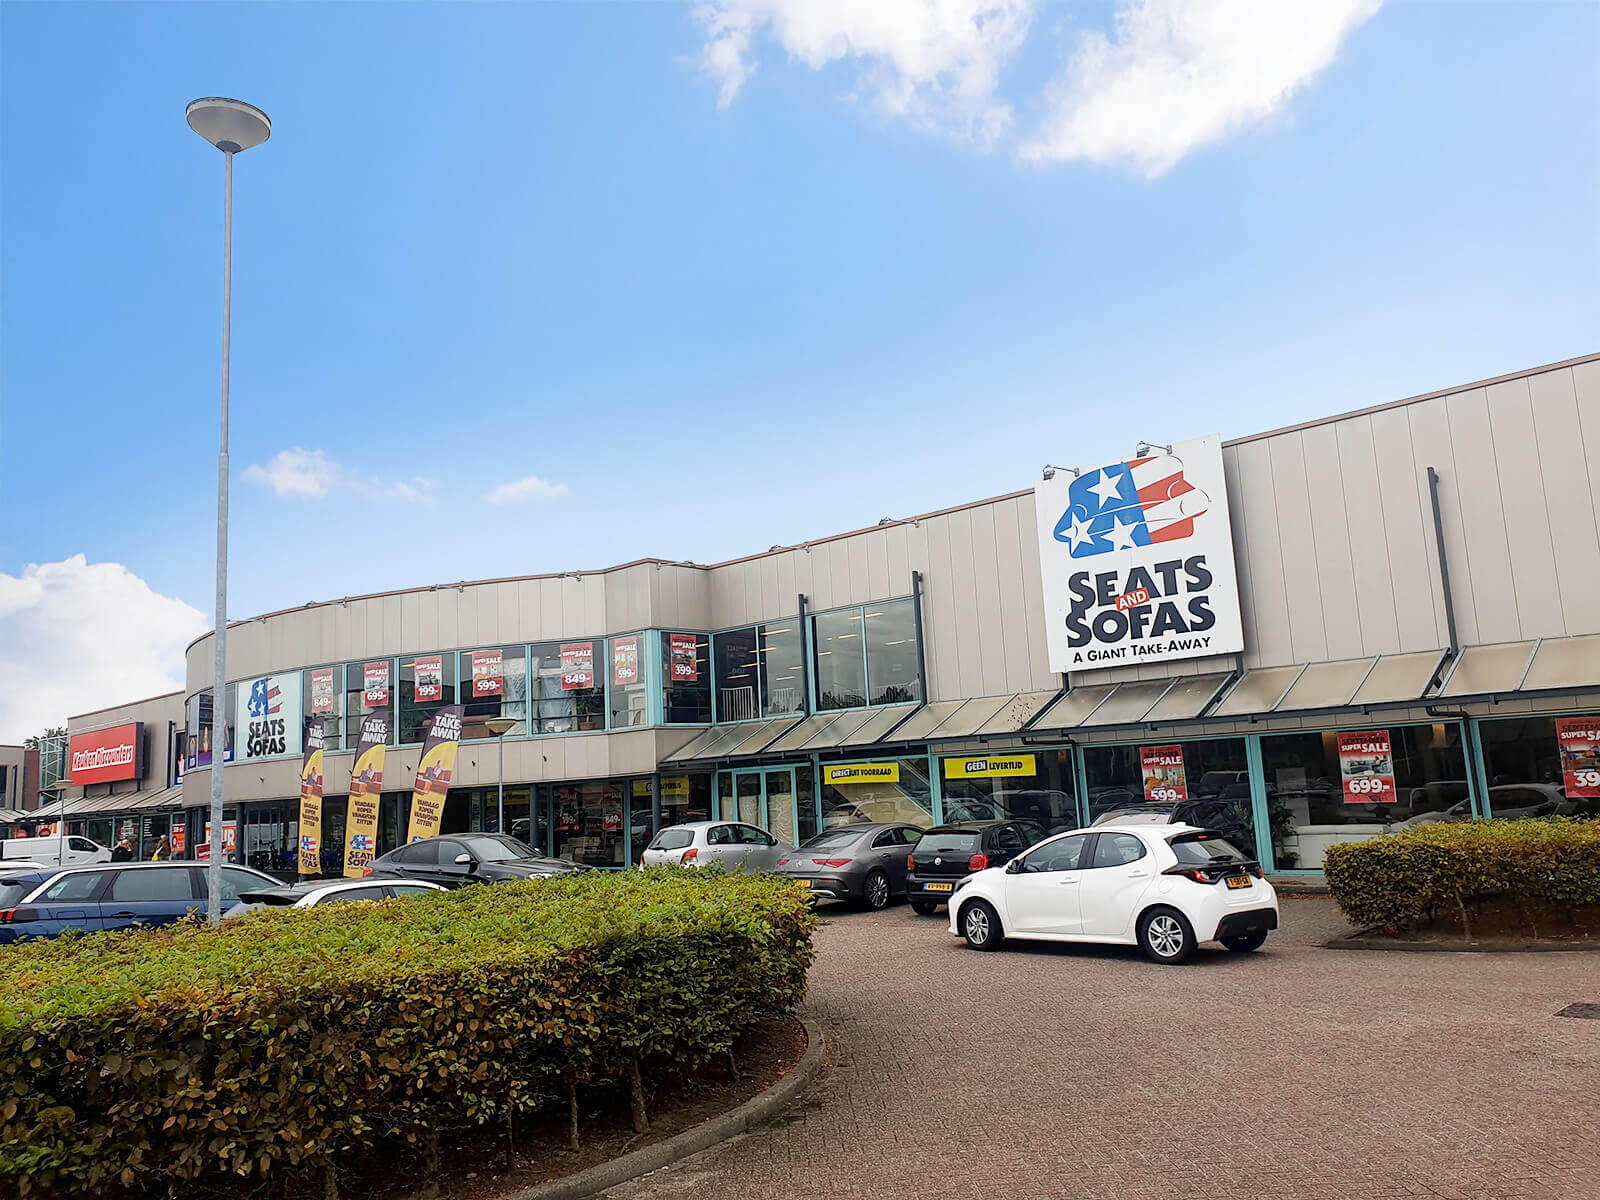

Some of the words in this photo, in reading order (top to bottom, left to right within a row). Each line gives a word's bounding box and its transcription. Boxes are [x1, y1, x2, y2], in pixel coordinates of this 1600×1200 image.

[1068, 555, 1212, 610] SEATS
[1119, 591, 1147, 609] AND
[1065, 596, 1216, 648] SOFAS
[1073, 652, 1083, 663] A
[1087, 647, 1126, 661] GIANT
[1130, 637, 1211, 656] TAKE-AWAY
[249, 718, 285, 739] SEATS
[430, 726, 460, 741] AWAY
[362, 732, 387, 744] AWAY
[246, 737, 286, 758] SOFAS
[1361, 743, 1389, 752] SALE
[966, 761, 986, 772] GEEN
[989, 761, 1023, 770] LEVERTIJD
[1160, 756, 1182, 765] SALE
